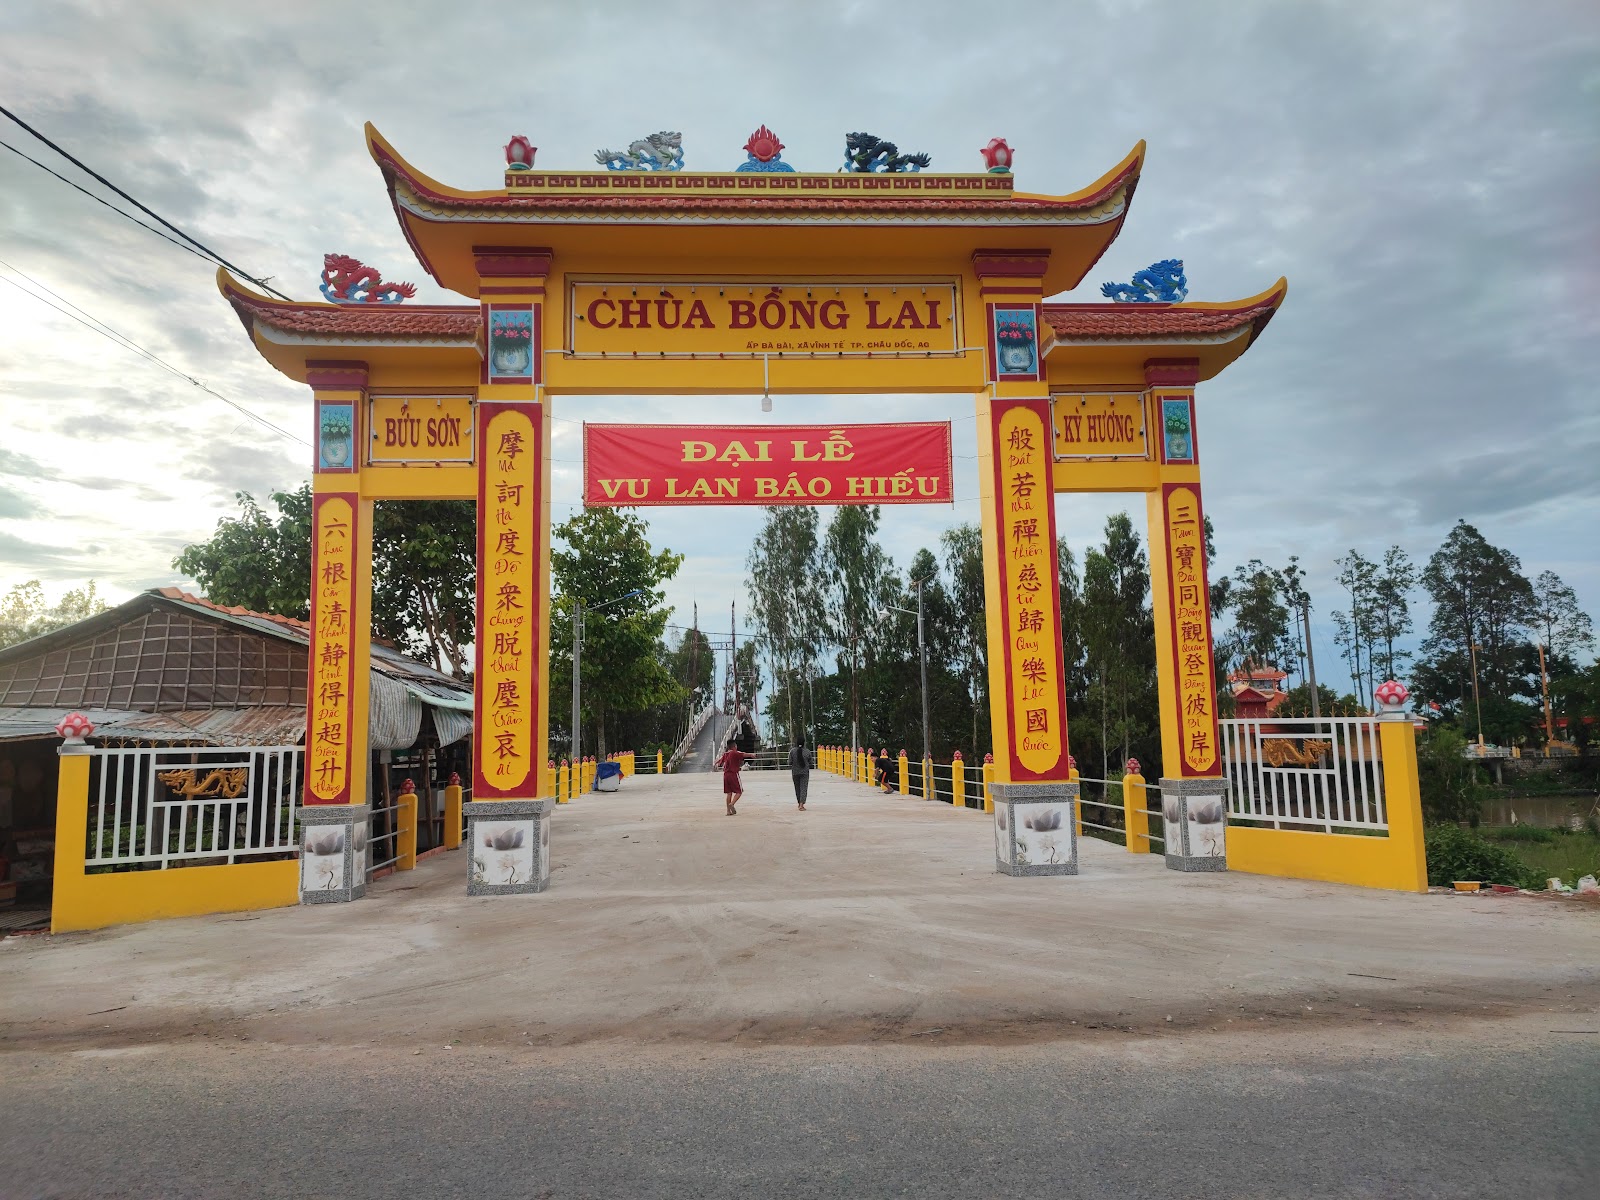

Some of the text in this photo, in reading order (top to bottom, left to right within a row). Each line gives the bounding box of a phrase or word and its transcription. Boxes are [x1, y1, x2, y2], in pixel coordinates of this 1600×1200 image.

[587, 286, 942, 330] CHÙA BỒNG LAI
[917, 341, 930, 349] AG
[426, 412, 461, 448] SƠN
[1063, 406, 1134, 443] KỲ HƯƠNG
[496, 429, 525, 460] 摩
[681, 430, 855, 467] ĐẠI LỄ
[495, 480, 524, 507] 訶
[597, 467, 940, 499] VU LAN BÁO HIẾU
[323, 517, 348, 538] 六
[495, 528, 524, 556] 度
[321, 560, 349, 585] 根
[1007, 425, 1049, 734] 般 若 禪 慈 歸 樂 國
[321, 600, 348, 628] 清
[1016, 636, 1039, 653] Quy
[1172, 505, 1210, 757] 三 寶 同 觀 登 彼 岸
[318, 681, 345, 708] 得
[492, 677, 520, 709] 塵
[315, 721, 345, 746] 超
[314, 757, 342, 783] 升
